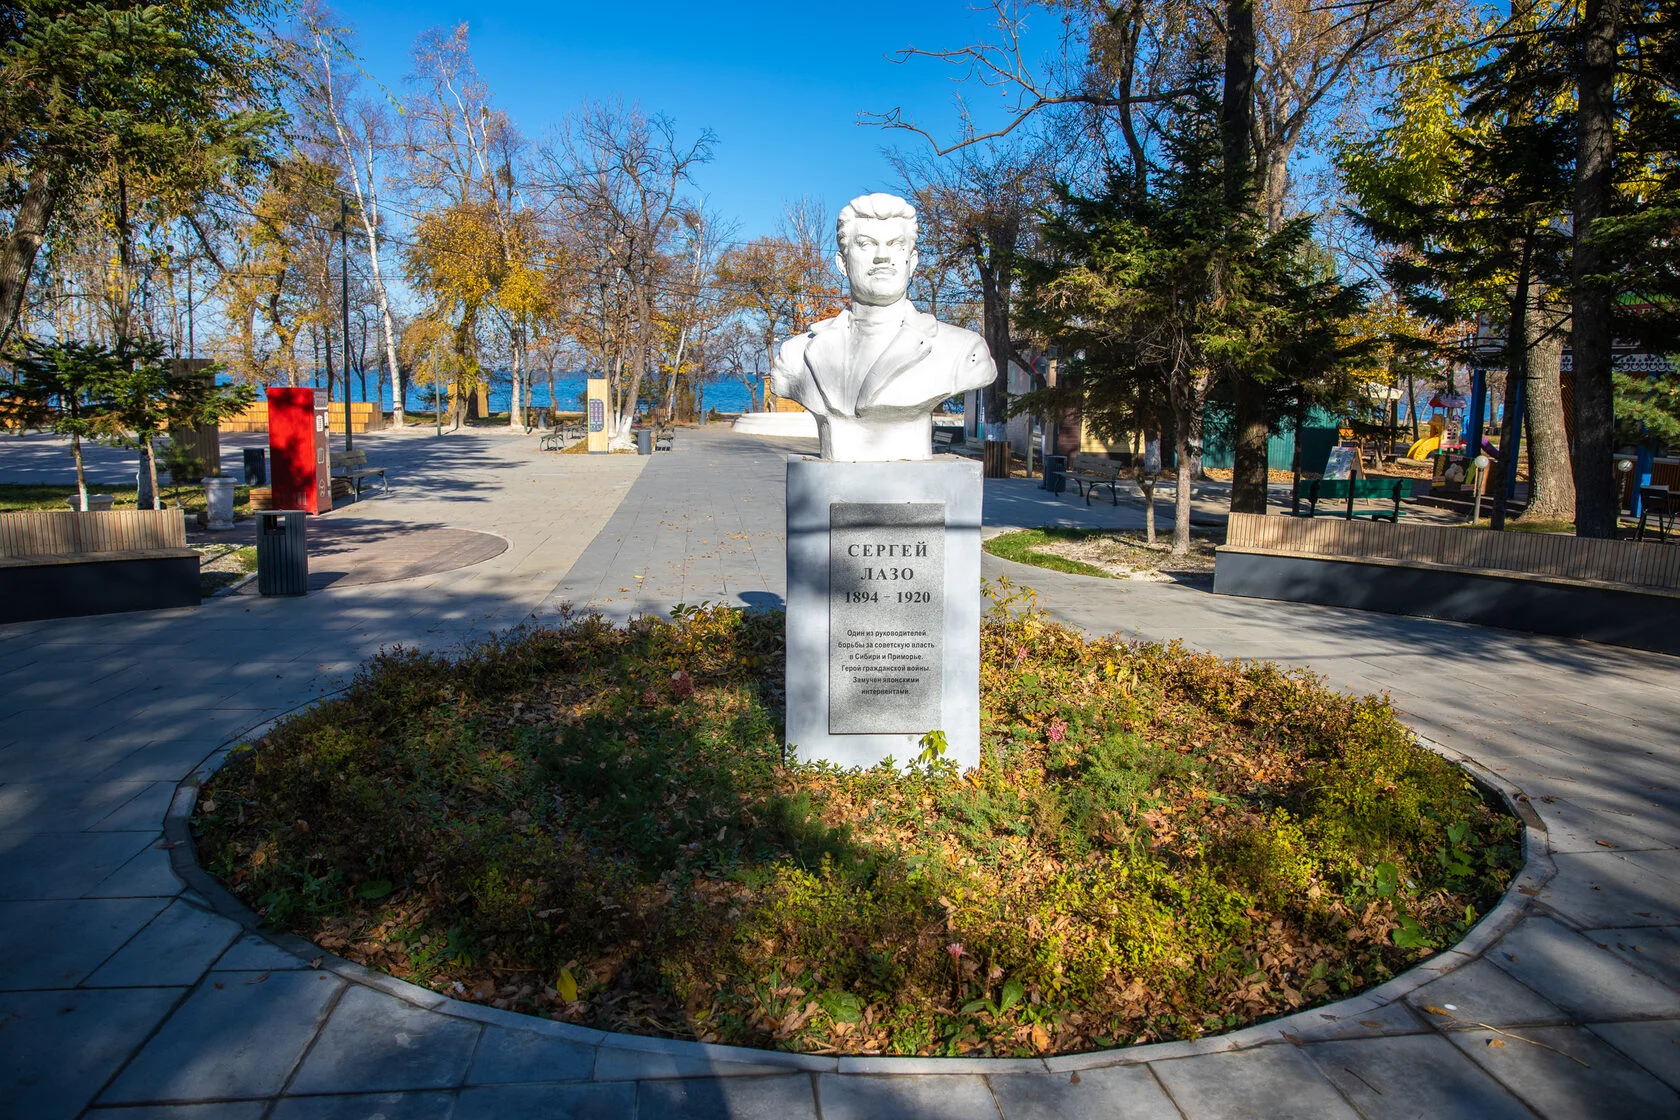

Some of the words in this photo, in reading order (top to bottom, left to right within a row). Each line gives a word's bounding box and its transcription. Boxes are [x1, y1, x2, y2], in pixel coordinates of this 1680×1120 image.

[848, 541, 928, 557] СЕРГЕЙ
[860, 568, 914, 580] ЛАЗО
[845, 591, 878, 604] 1894
[897, 591, 930, 604] 1920
